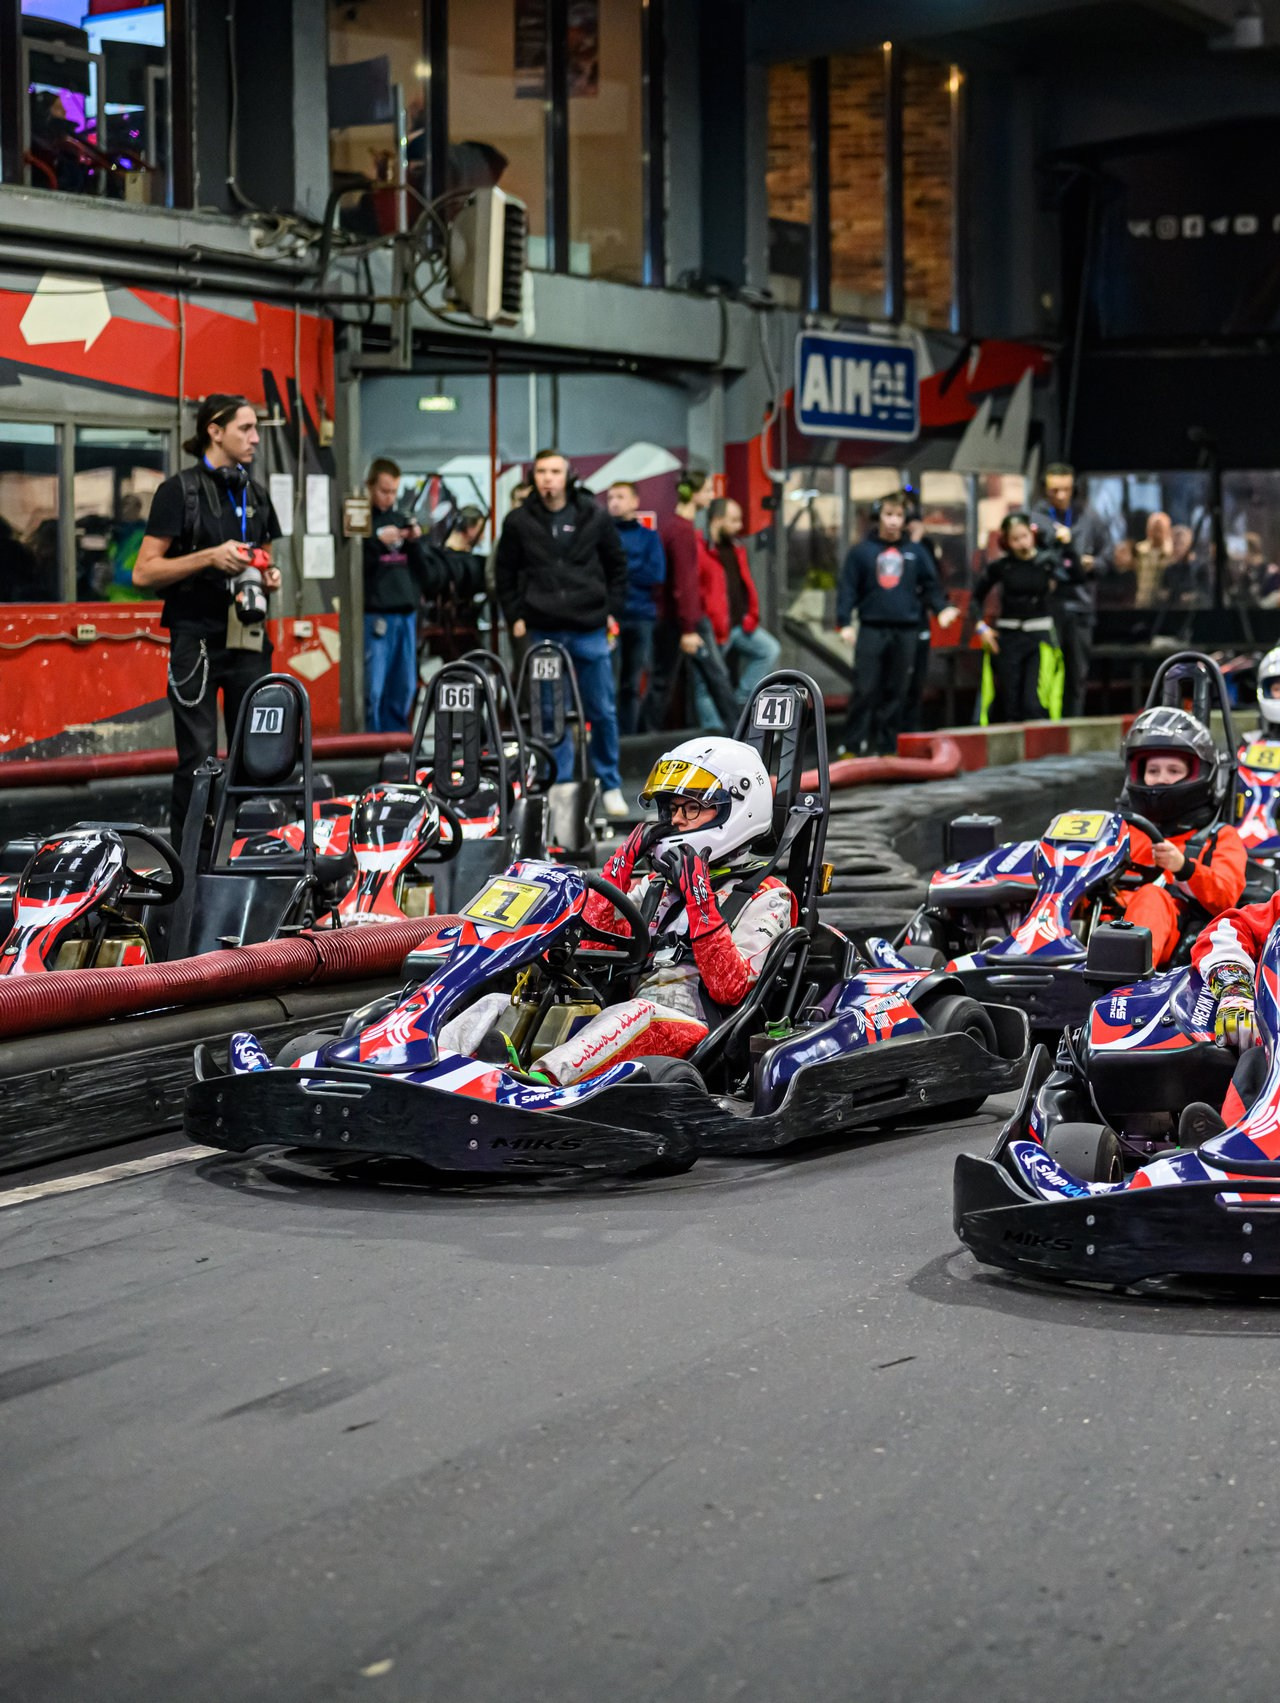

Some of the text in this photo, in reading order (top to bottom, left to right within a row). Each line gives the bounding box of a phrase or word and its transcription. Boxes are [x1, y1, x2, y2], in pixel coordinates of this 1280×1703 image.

[445, 686, 470, 708] 66
[255, 709, 279, 732] 70
[761, 698, 787, 724] 41
[1257, 750, 1275, 766] 8
[1063, 820, 1091, 837] 3
[483, 891, 521, 922] 1
[491, 1137, 584, 1151] MIKS
[1004, 1230, 1074, 1251] MIKS
